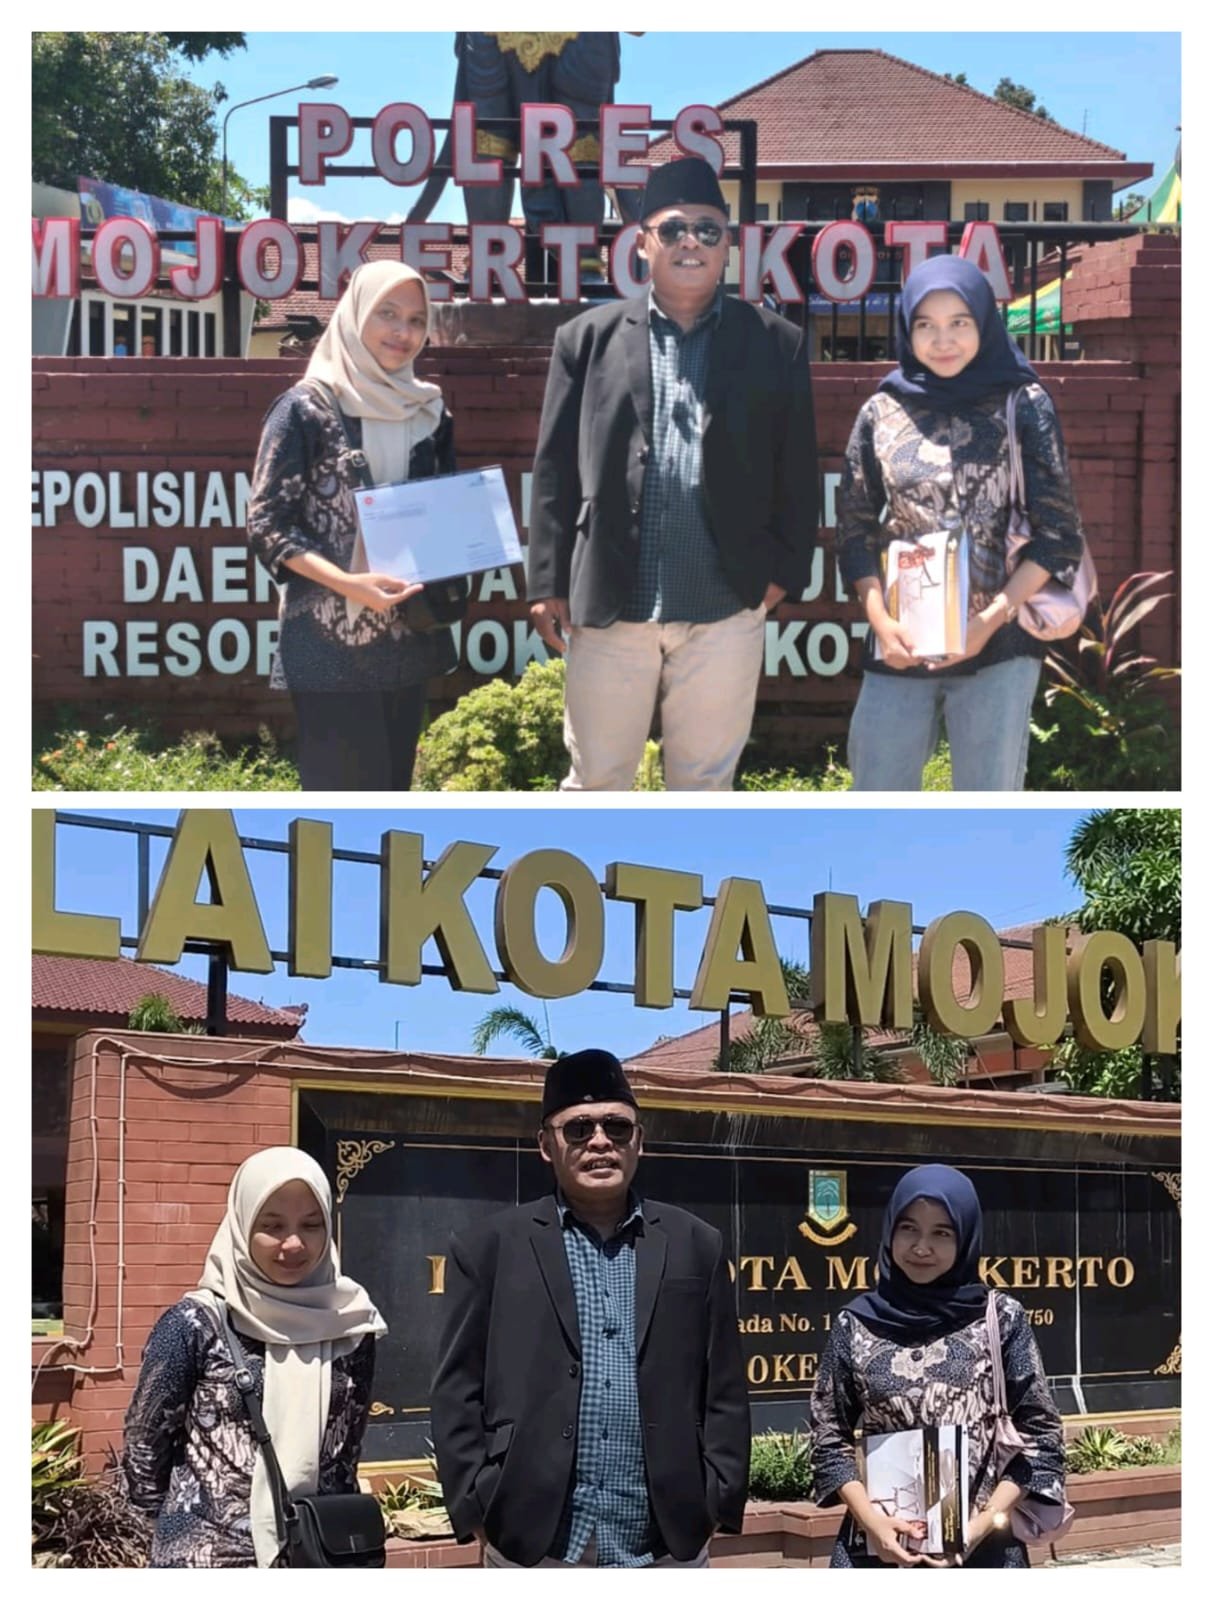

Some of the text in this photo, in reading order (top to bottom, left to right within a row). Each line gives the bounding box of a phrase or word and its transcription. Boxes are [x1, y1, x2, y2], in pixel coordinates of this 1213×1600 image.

[298, 102, 726, 189] POLRES
[31, 215, 1014, 303] MOJOKERTO KOTA
[379, 829, 790, 1019] KOTA
[728, 1256, 812, 1290] TA
[779, 1313, 815, 1332] No.
